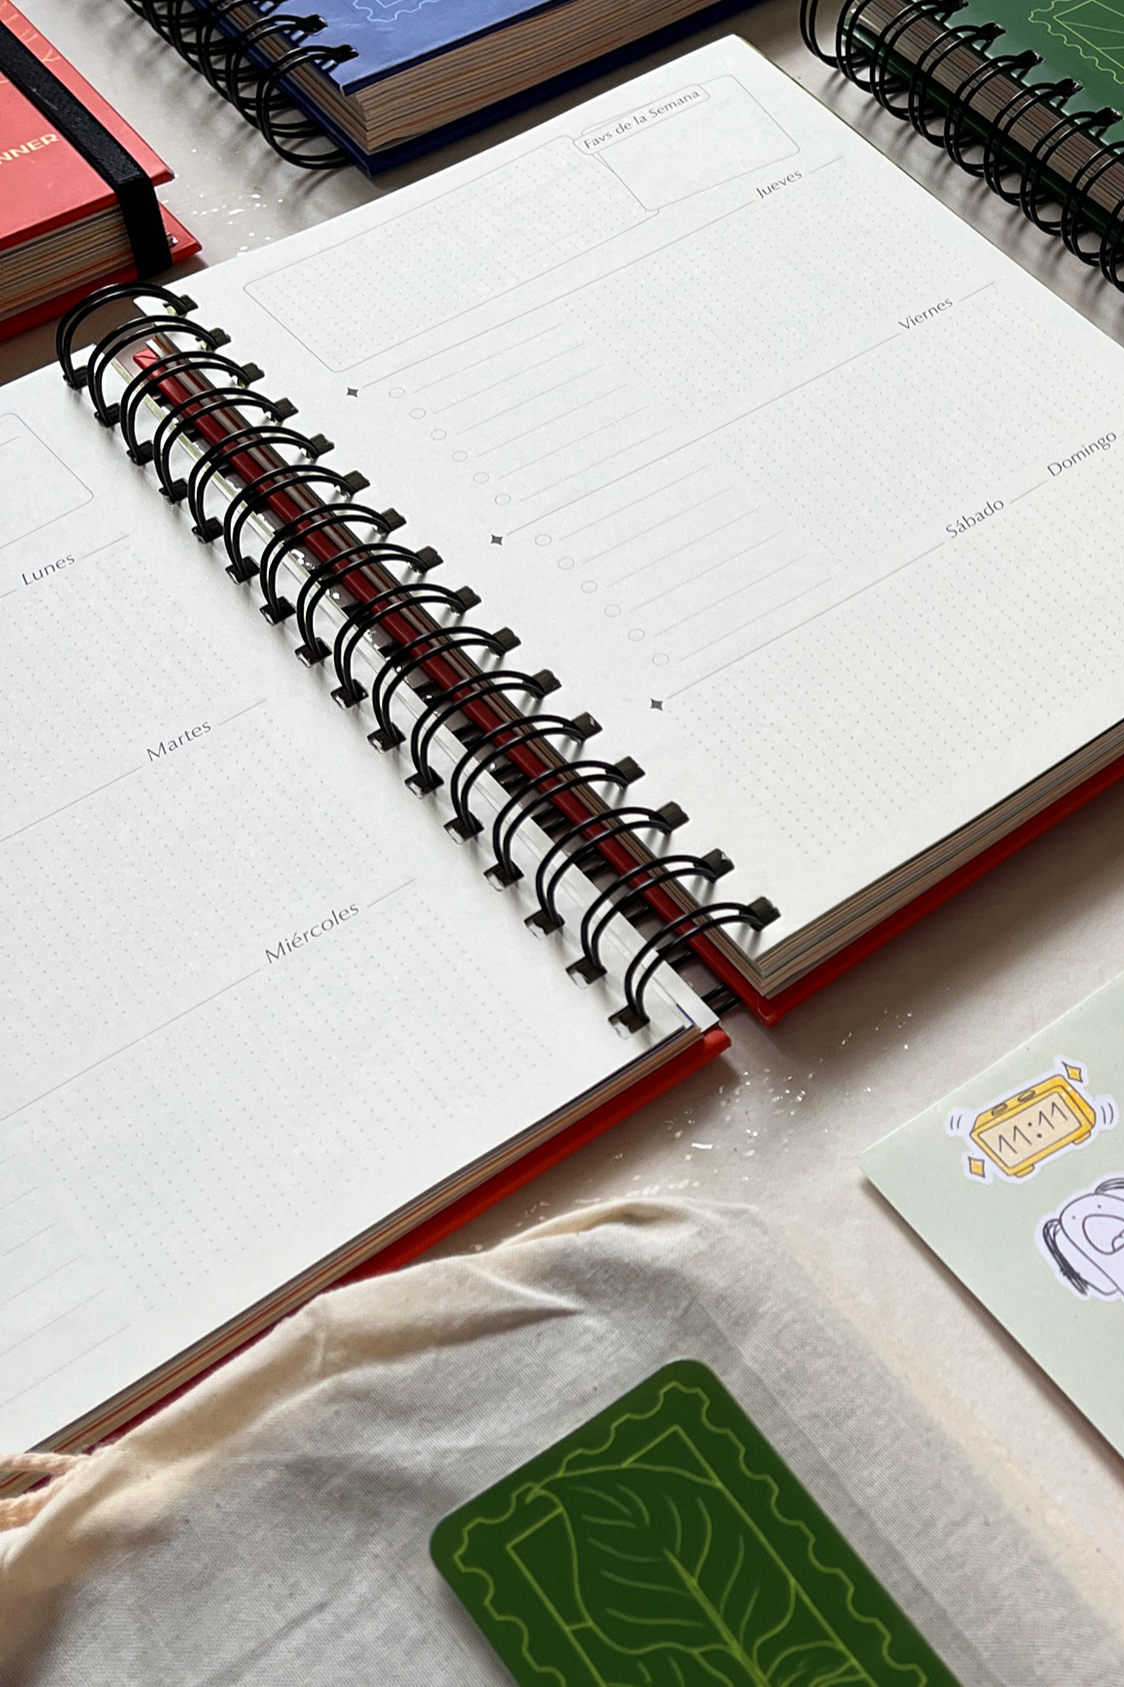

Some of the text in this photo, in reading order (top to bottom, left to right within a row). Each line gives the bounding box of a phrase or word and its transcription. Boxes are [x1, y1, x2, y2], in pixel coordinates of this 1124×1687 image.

[583, 90, 700, 149] Favs de la Semana
[756, 170, 803, 199] Jueves
[897, 298, 954, 330] Viernes
[1046, 431, 1117, 477] Domingo
[945, 499, 1005, 539] Sábado
[21, 551, 76, 588] Lunes
[146, 717, 212, 763] Martes
[265, 900, 360, 964] Miércoles
[998, 1101, 1068, 1155] 11:11
